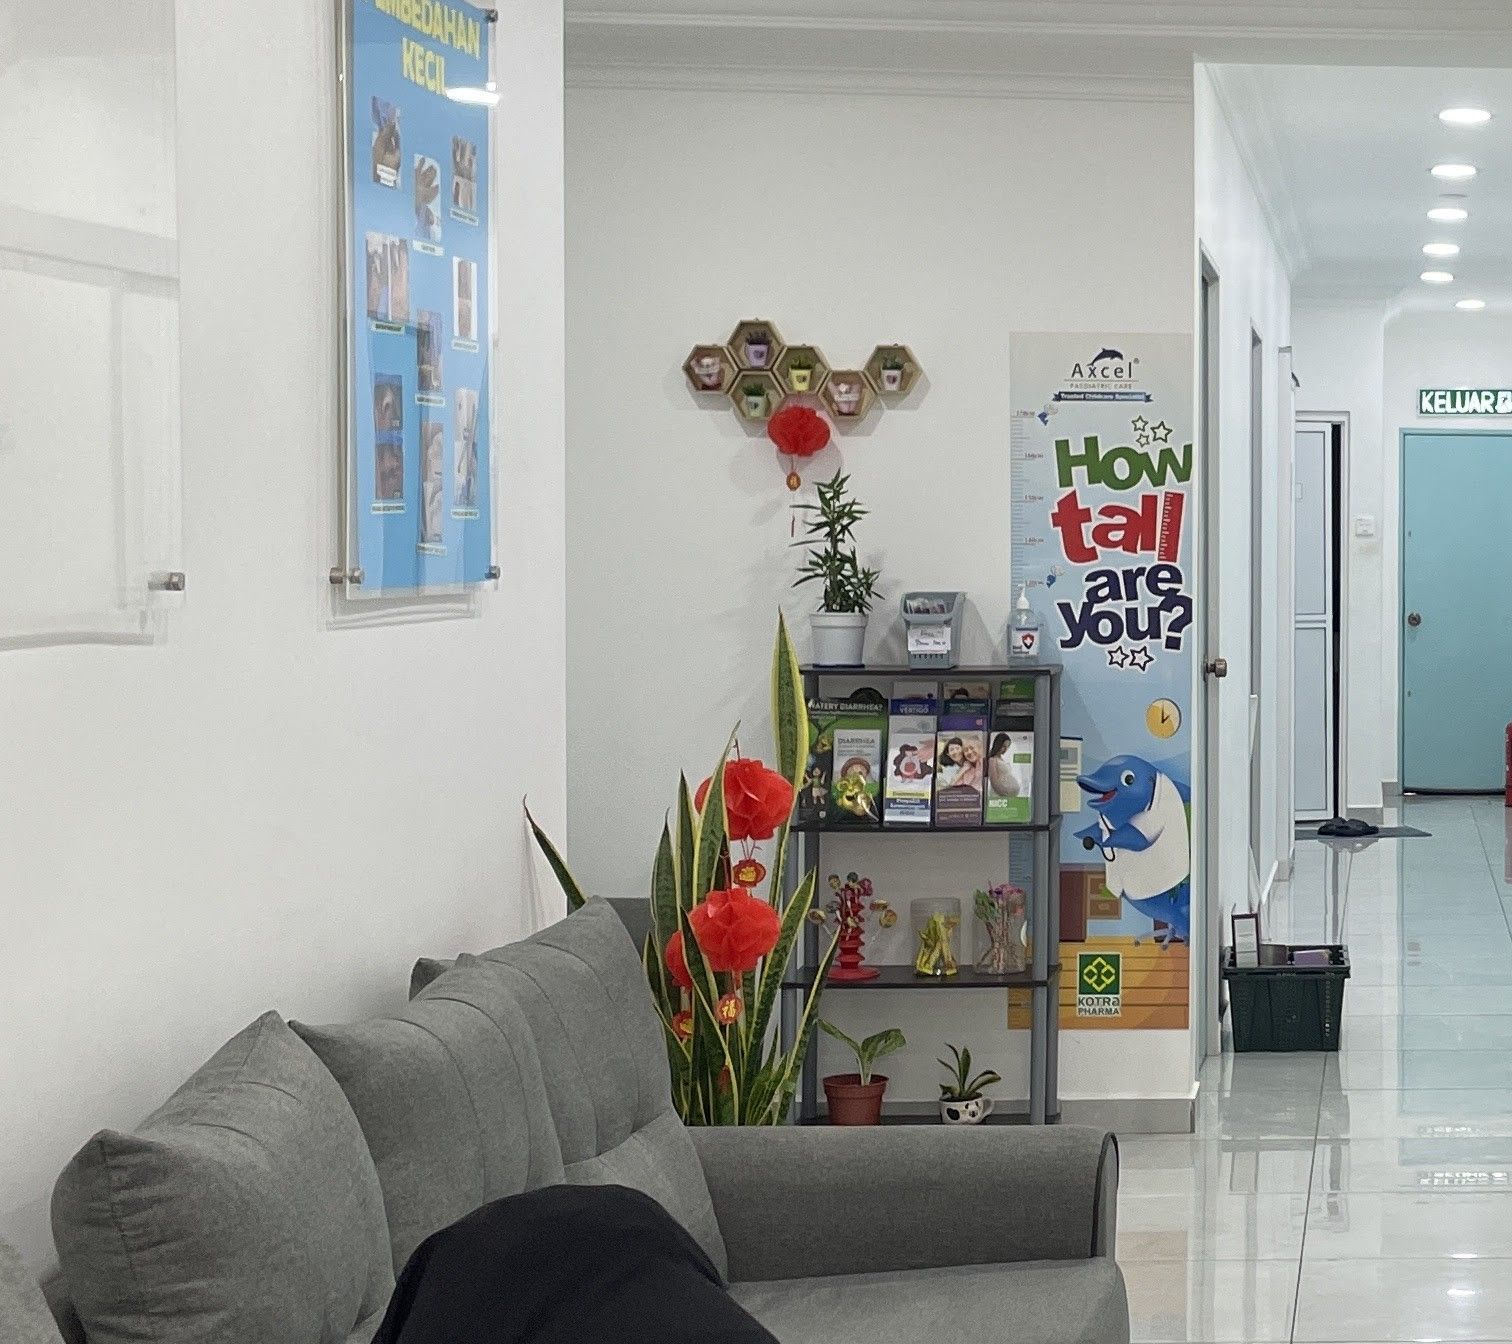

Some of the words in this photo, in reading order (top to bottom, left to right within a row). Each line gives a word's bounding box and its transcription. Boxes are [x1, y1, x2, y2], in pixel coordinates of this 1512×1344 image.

[1071, 362, 1133, 379] Axcel
[1421, 391, 1495, 414] KELUAR
[1055, 436, 1192, 490] How
[1051, 489, 1184, 564] tall
[1085, 564, 1183, 603] are
[1057, 594, 1192, 650] you?
[1078, 1007, 1120, 1016] PHARMA
